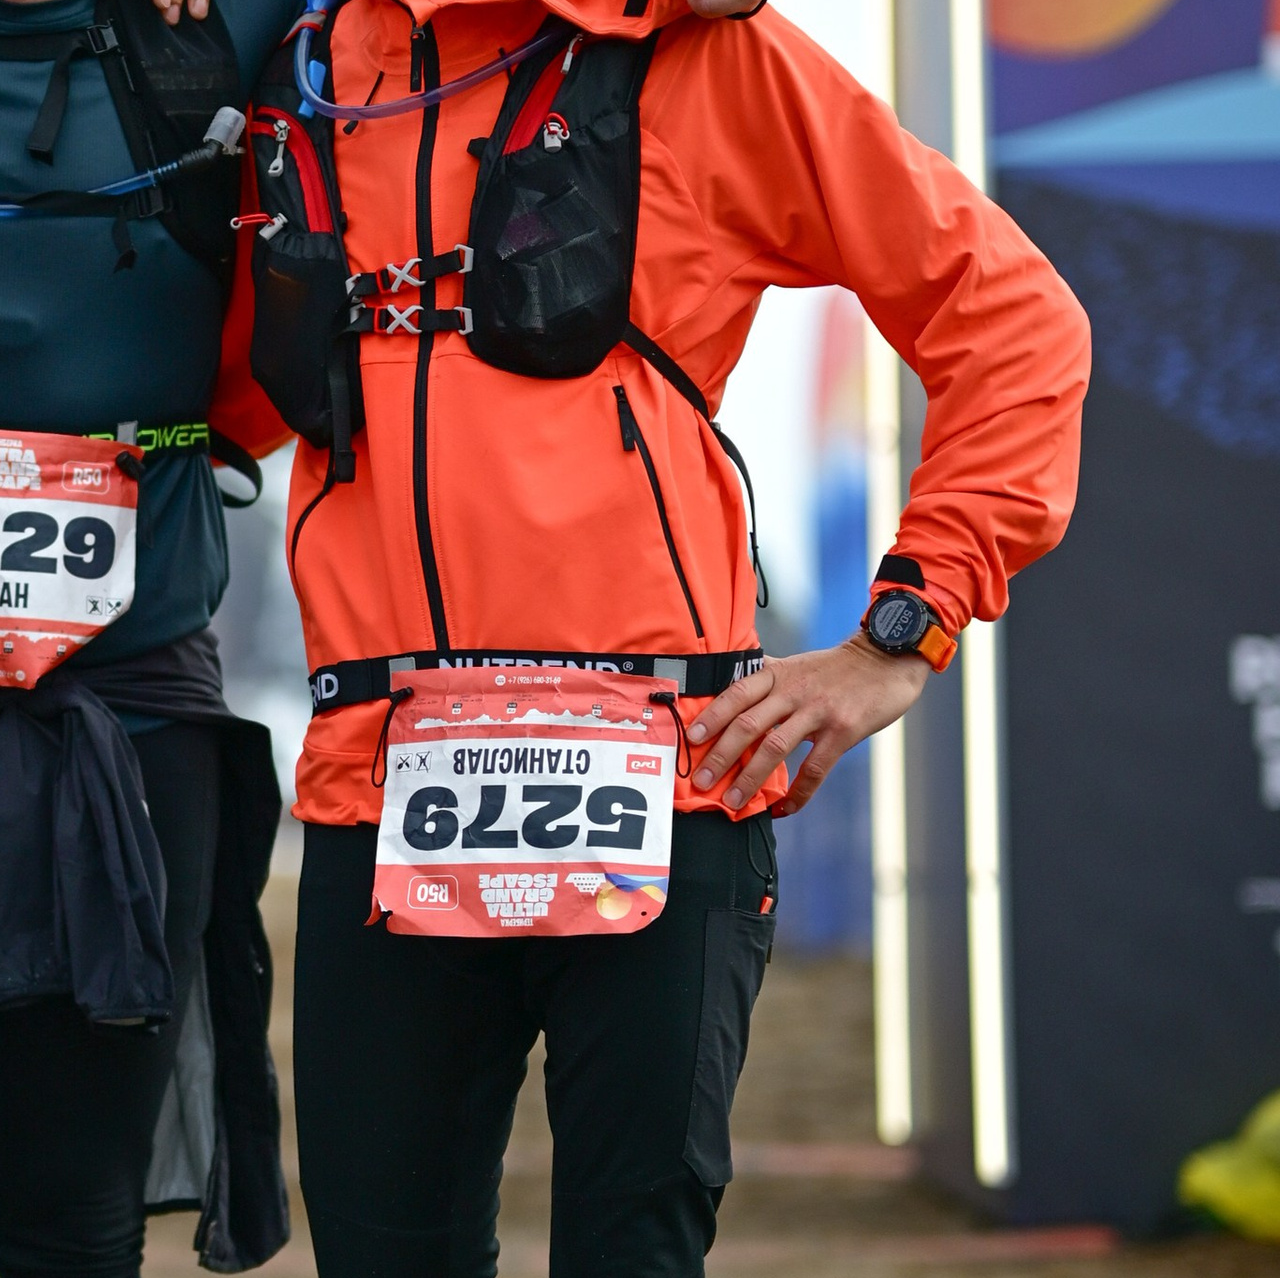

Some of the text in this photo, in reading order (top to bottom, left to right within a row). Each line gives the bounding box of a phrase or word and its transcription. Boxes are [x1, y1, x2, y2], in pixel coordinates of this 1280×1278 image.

[72, 467, 102, 486] R50
[453, 747, 591, 775] СТАНИСЛАВ
[402, 784, 648, 851] 5279
[478, 872, 559, 889] ESCAPE
[416, 882, 449, 903] R50
[480, 887, 555, 903] GRAND
[485, 901, 549, 918] ULTRA
